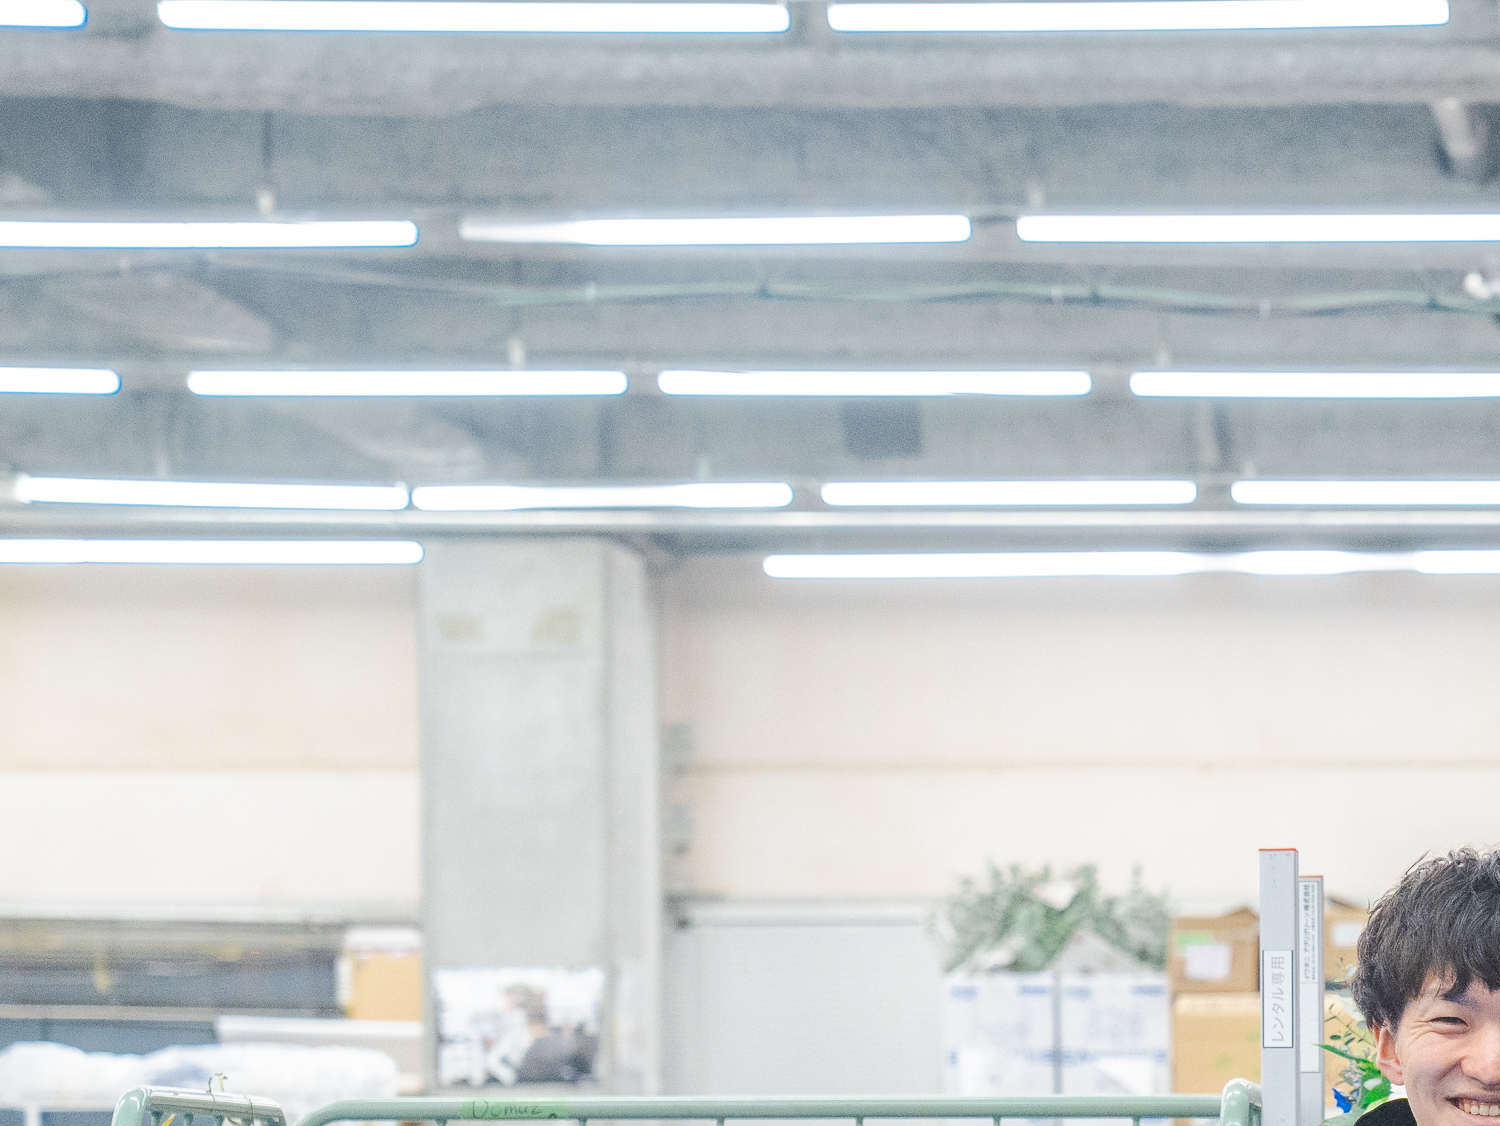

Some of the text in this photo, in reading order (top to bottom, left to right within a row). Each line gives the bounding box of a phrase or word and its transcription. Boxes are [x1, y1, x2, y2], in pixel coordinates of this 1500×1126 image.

[1271, 956, 1285, 1042] レンタル専用
